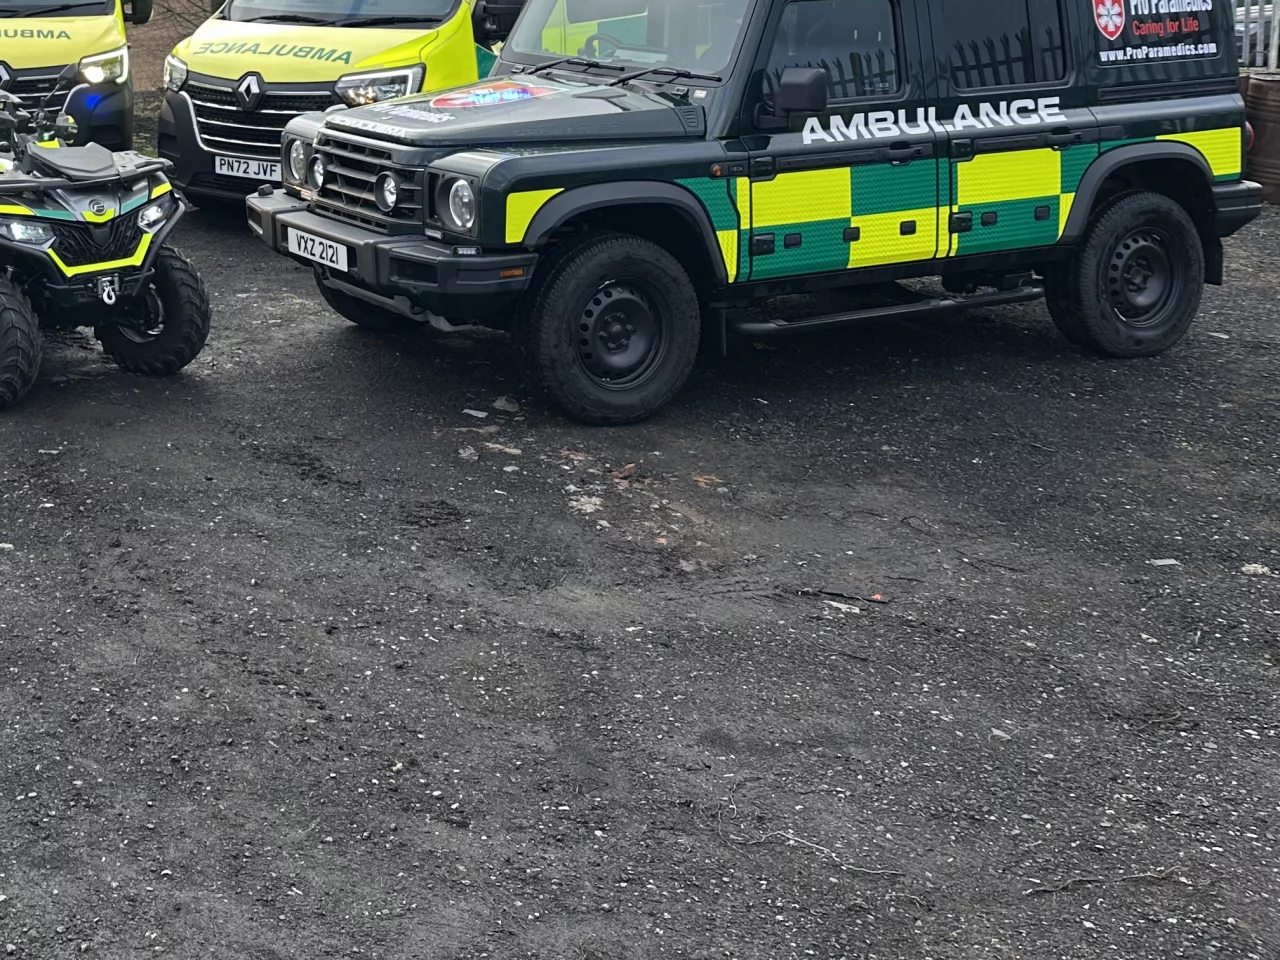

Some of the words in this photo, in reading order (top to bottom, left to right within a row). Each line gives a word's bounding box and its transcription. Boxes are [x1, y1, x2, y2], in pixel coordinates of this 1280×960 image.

[1132, 20, 1165, 37] Caring
[1166, 17, 1181, 33] for
[1181, 16, 1200, 32] Life
[1099, 42, 1217, 61] www.ProParamedics.com
[801, 96, 1067, 145] AMBULANCE
[219, 158, 250, 175] PN72
[253, 163, 277, 178] JVF
[295, 237, 316, 257] VXZ
[318, 241, 339, 265] 2121
